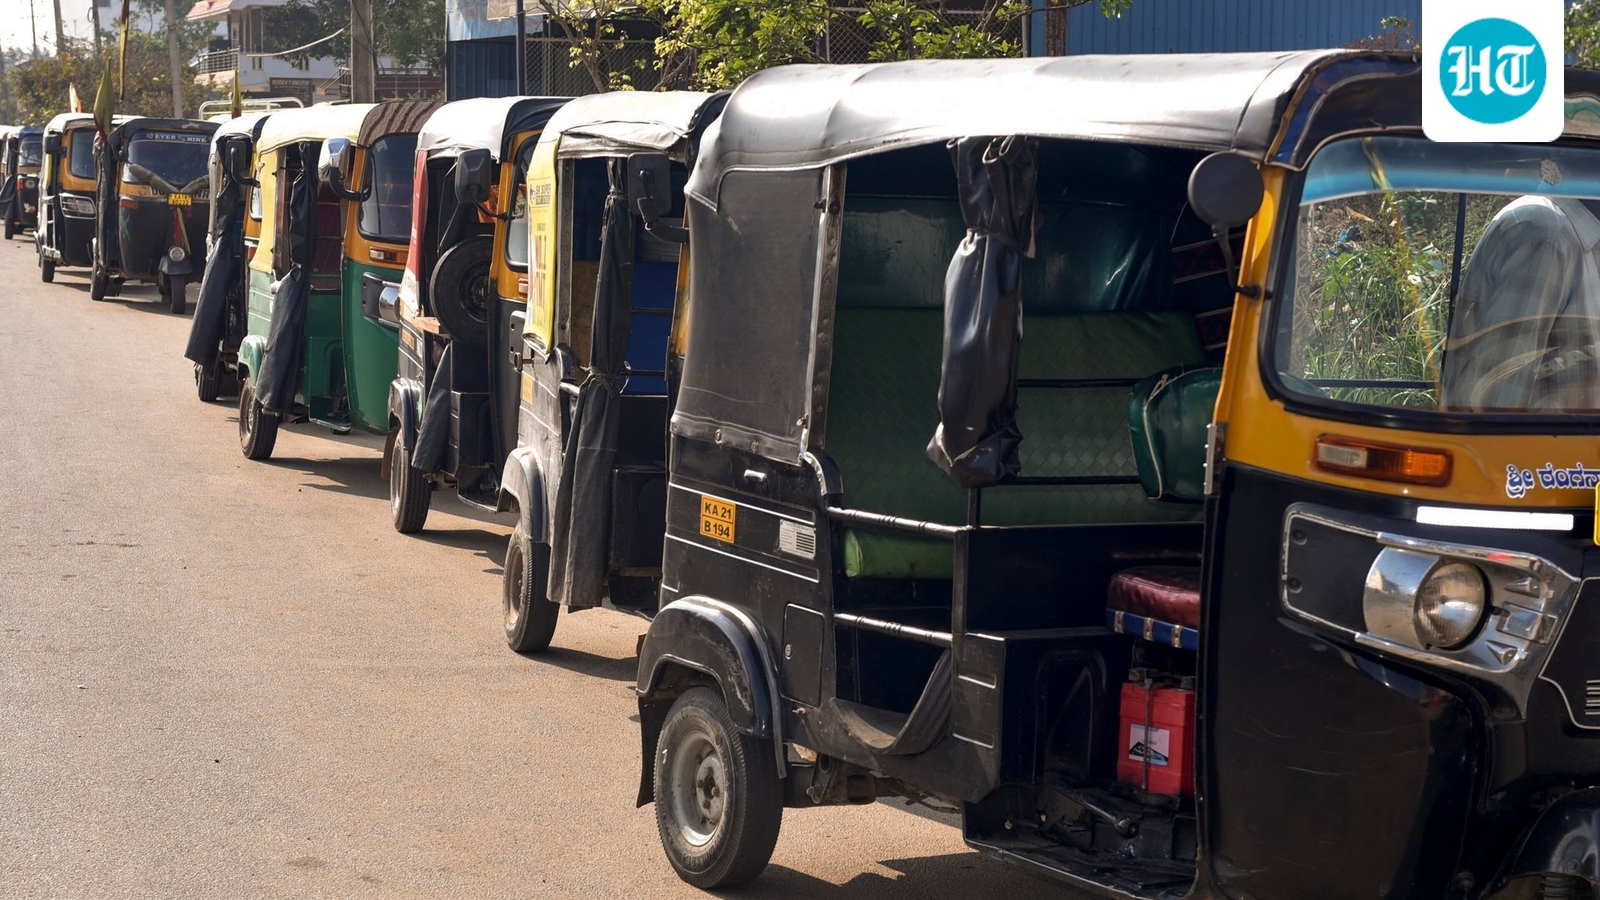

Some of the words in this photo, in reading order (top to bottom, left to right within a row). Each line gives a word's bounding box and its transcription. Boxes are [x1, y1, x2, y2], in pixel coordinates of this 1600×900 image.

[1506, 464, 1535, 498] ಶ್ರೀ
[704, 502, 718, 516] KA
[720, 506, 731, 519] 21
[704, 520, 711, 532] B
[713, 523, 730, 538] 194
